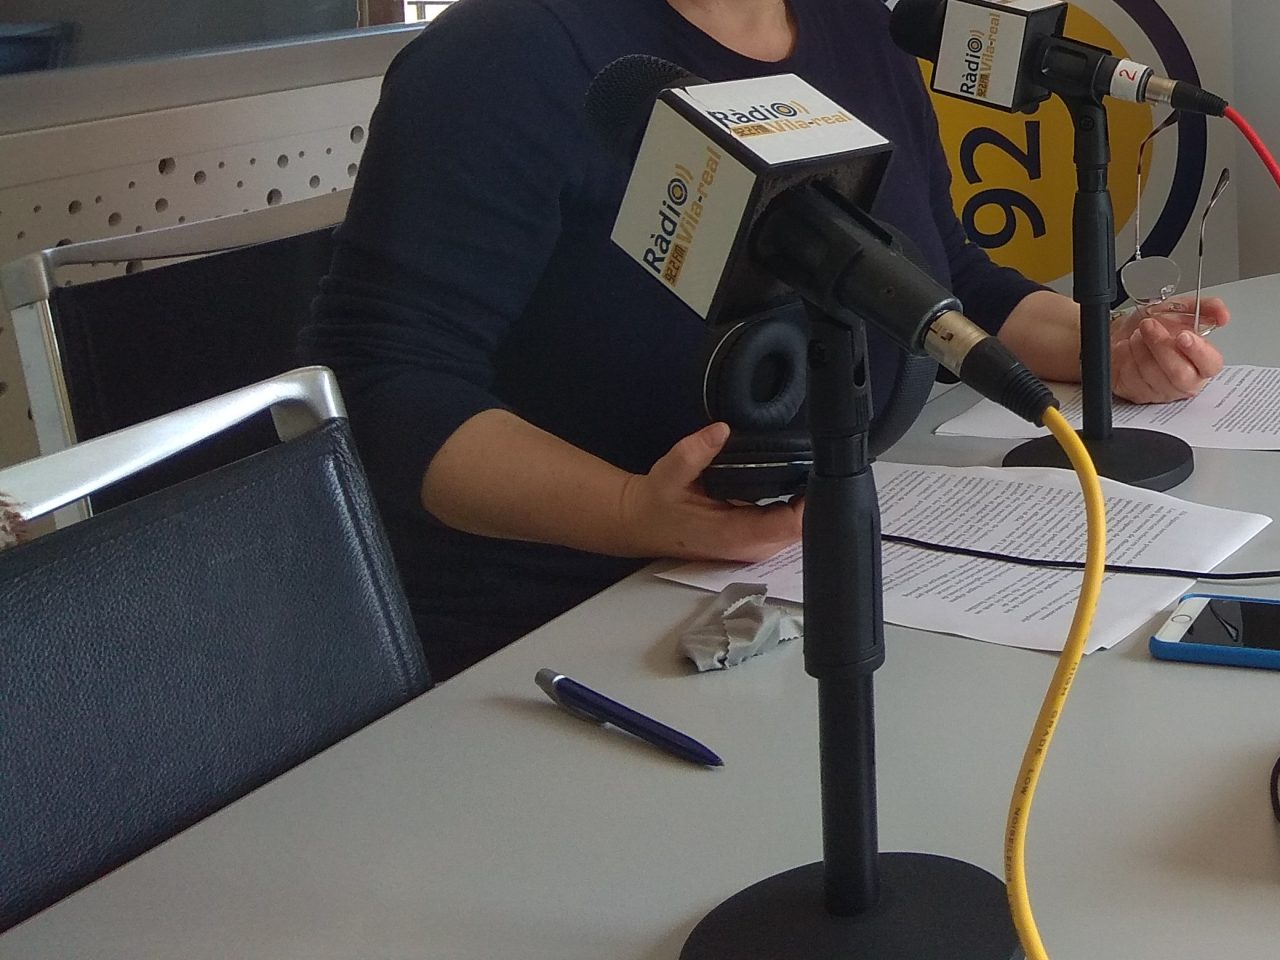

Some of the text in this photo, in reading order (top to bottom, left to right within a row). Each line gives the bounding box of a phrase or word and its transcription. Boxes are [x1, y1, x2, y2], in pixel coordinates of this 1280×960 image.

[980, 12, 1001, 73] Vila-real
[765, 110, 853, 134] Vila-real
[675, 146, 722, 244] Vila-real
